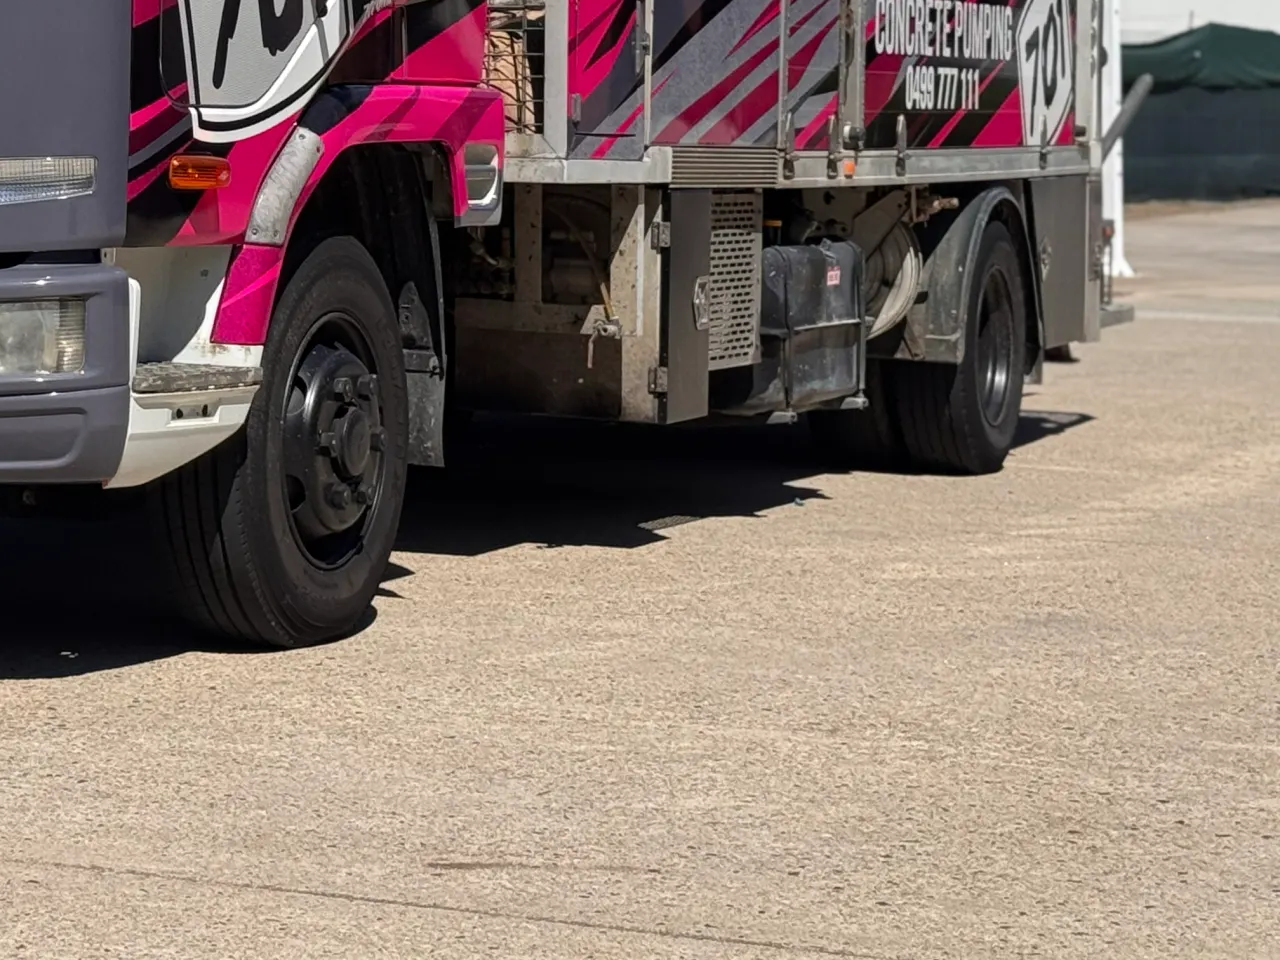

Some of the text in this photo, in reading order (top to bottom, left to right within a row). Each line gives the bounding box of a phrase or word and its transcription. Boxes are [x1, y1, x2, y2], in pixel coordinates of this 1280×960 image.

[954, 1, 1013, 61] PUMPING
[905, 66, 980, 110] 0499 777 111
